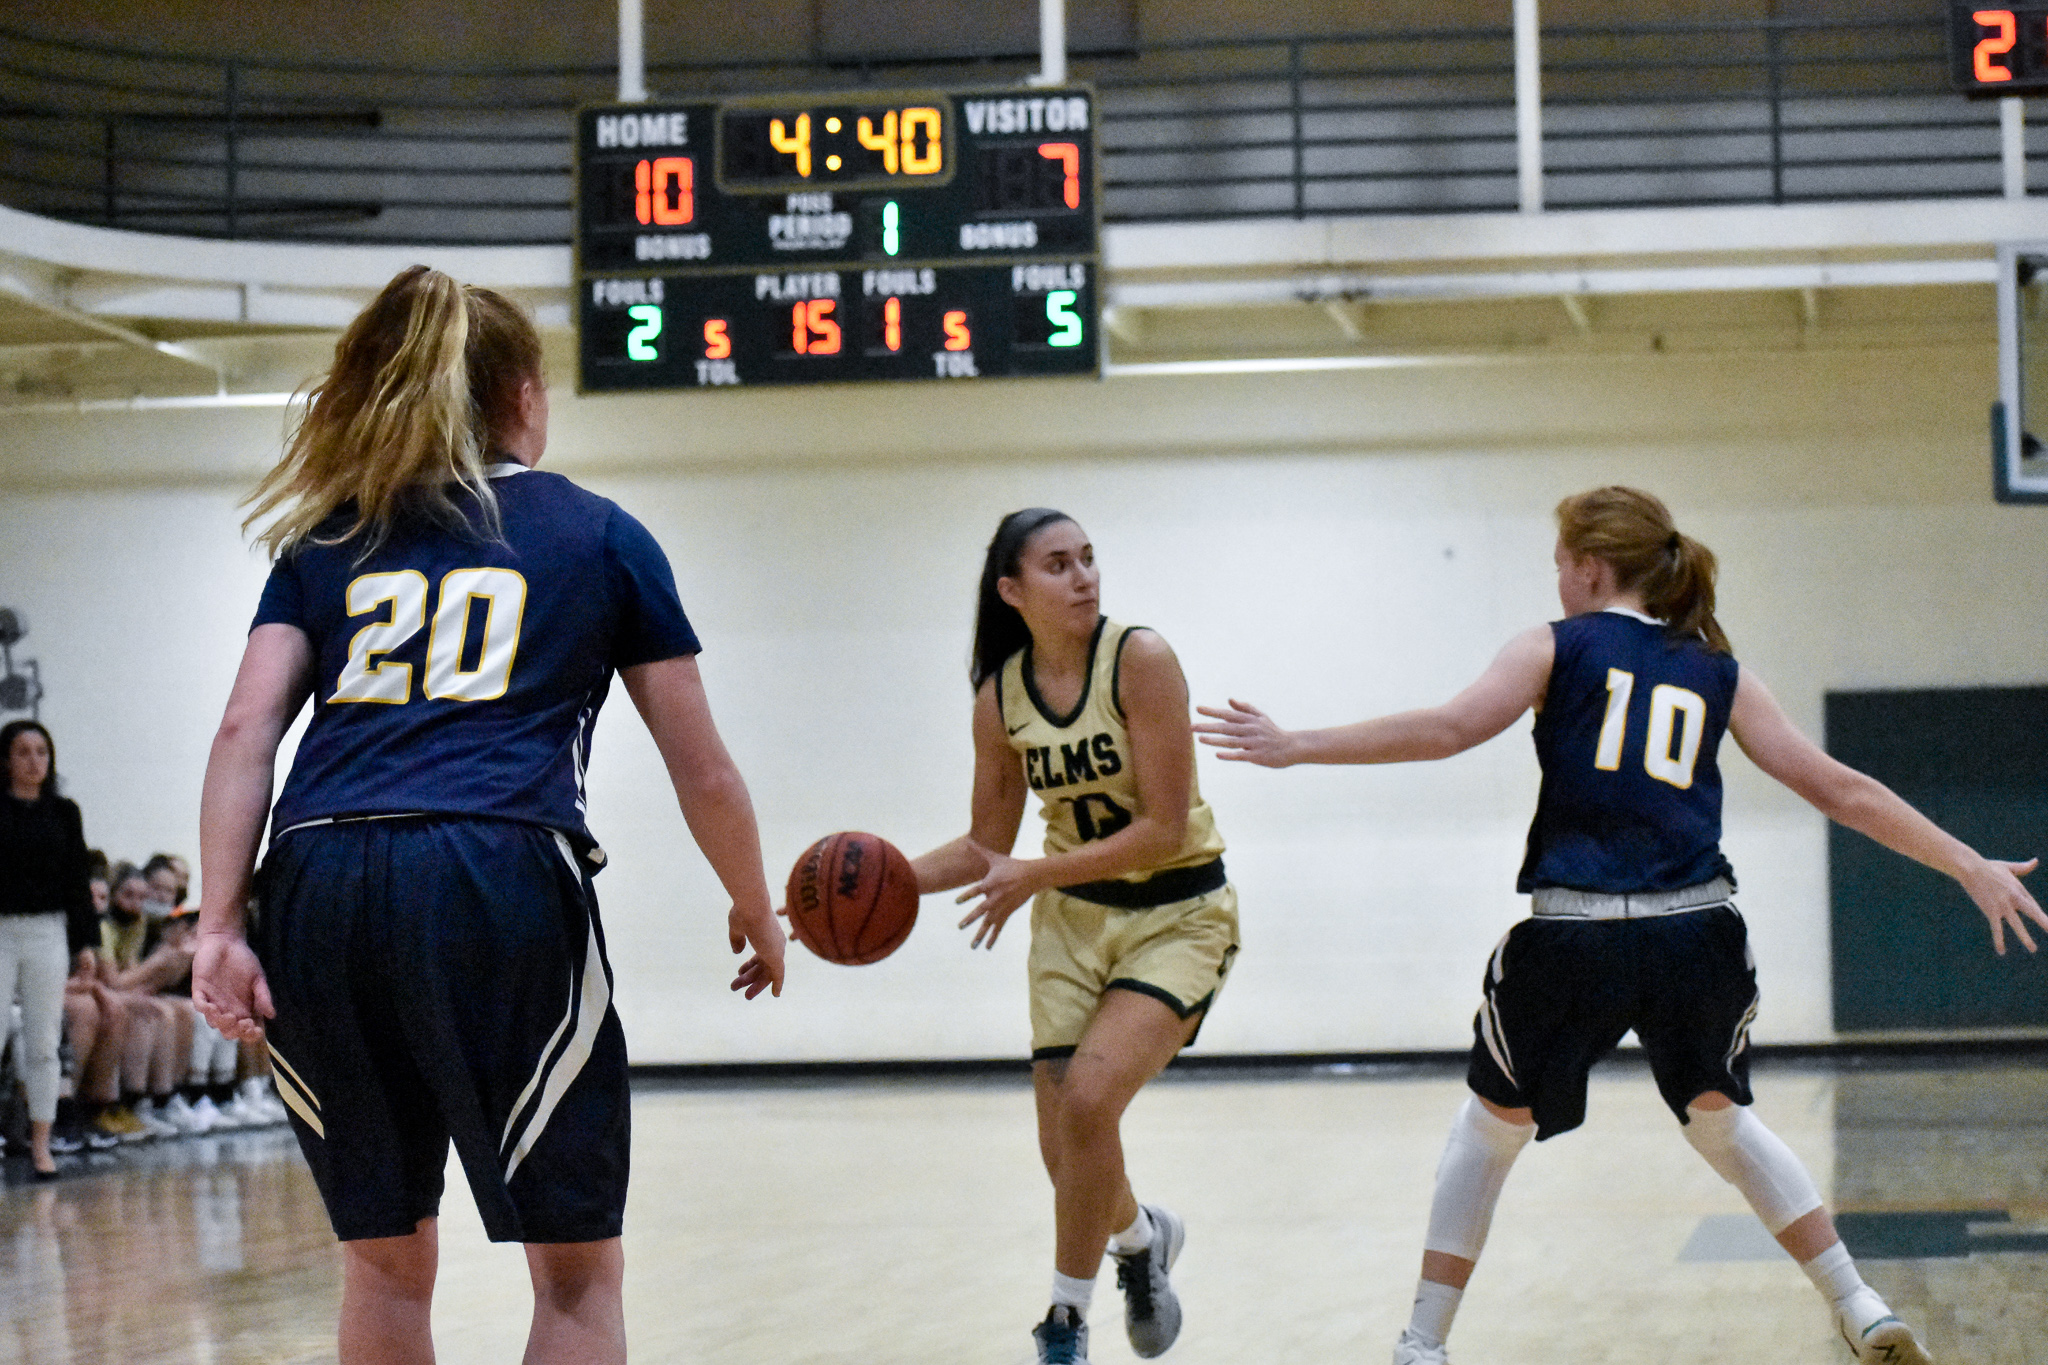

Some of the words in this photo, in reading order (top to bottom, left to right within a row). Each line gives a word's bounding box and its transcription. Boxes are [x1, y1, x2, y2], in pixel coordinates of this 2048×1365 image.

[597, 112, 688, 148] HOME
[965, 98, 1089, 134] VISITOR
[769, 107, 942, 178] 4:40
[635, 157, 694, 226] 10
[1038, 143, 1079, 209] 7
[768, 212, 853, 240] PERIOD
[882, 201, 899, 256] 1
[960, 221, 1038, 250] BONUS
[635, 234, 711, 261] BONUS
[593, 278, 664, 306] FOULS
[755, 272, 841, 300] PLAYER
[862, 268, 936, 296] FOULS
[1012, 263, 1085, 292] FOULS
[628, 305, 662, 361] 2
[792, 299, 841, 355] 15
[885, 297, 900, 351] 1
[943, 310, 971, 351] 5
[1046, 290, 1083, 347] 5
[704, 319, 731, 359] 5
[695, 360, 740, 385] TOL
[933, 352, 979, 377] TOL
[326, 567, 527, 705] 20
[1594, 667, 1707, 790] 10
[1026, 732, 1122, 790] ELMS
